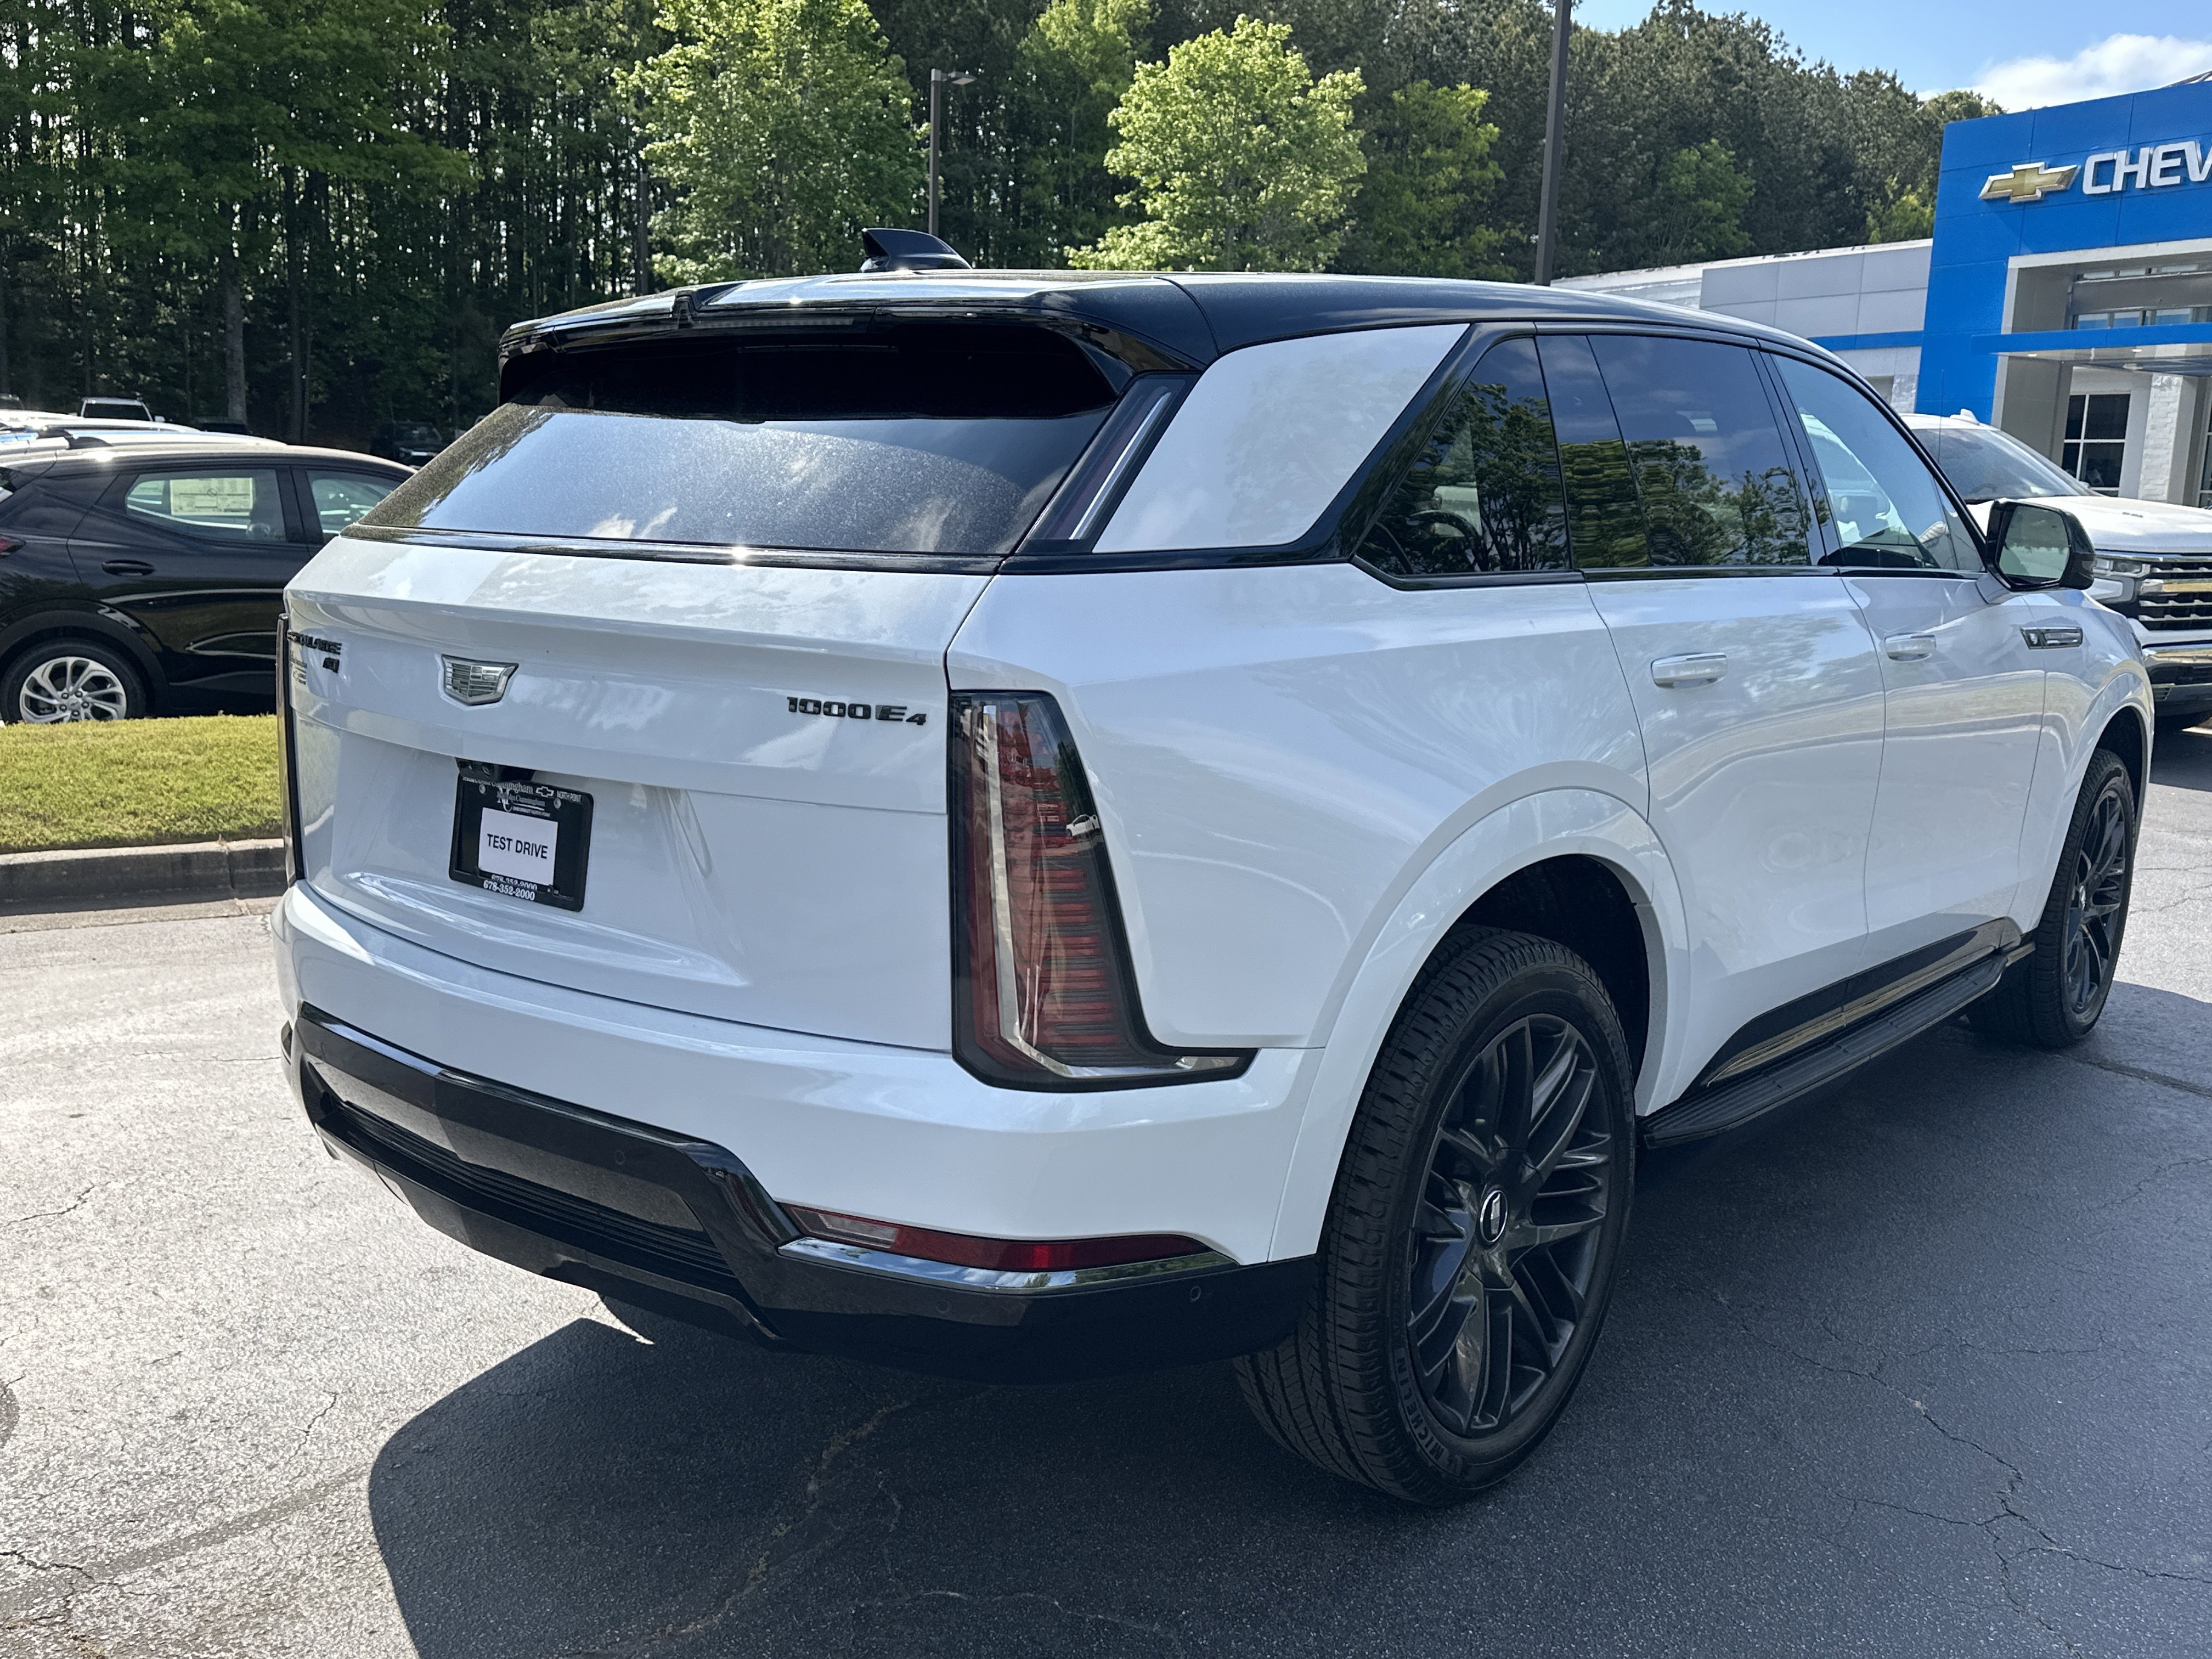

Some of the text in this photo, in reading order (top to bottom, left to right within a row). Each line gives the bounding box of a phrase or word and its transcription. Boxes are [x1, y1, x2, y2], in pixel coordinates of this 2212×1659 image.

[487, 833, 548, 859] TEST DRIVE
[483, 879, 535, 901] 678-352-2000
[1396, 1357, 1445, 1461] MICHELIN
